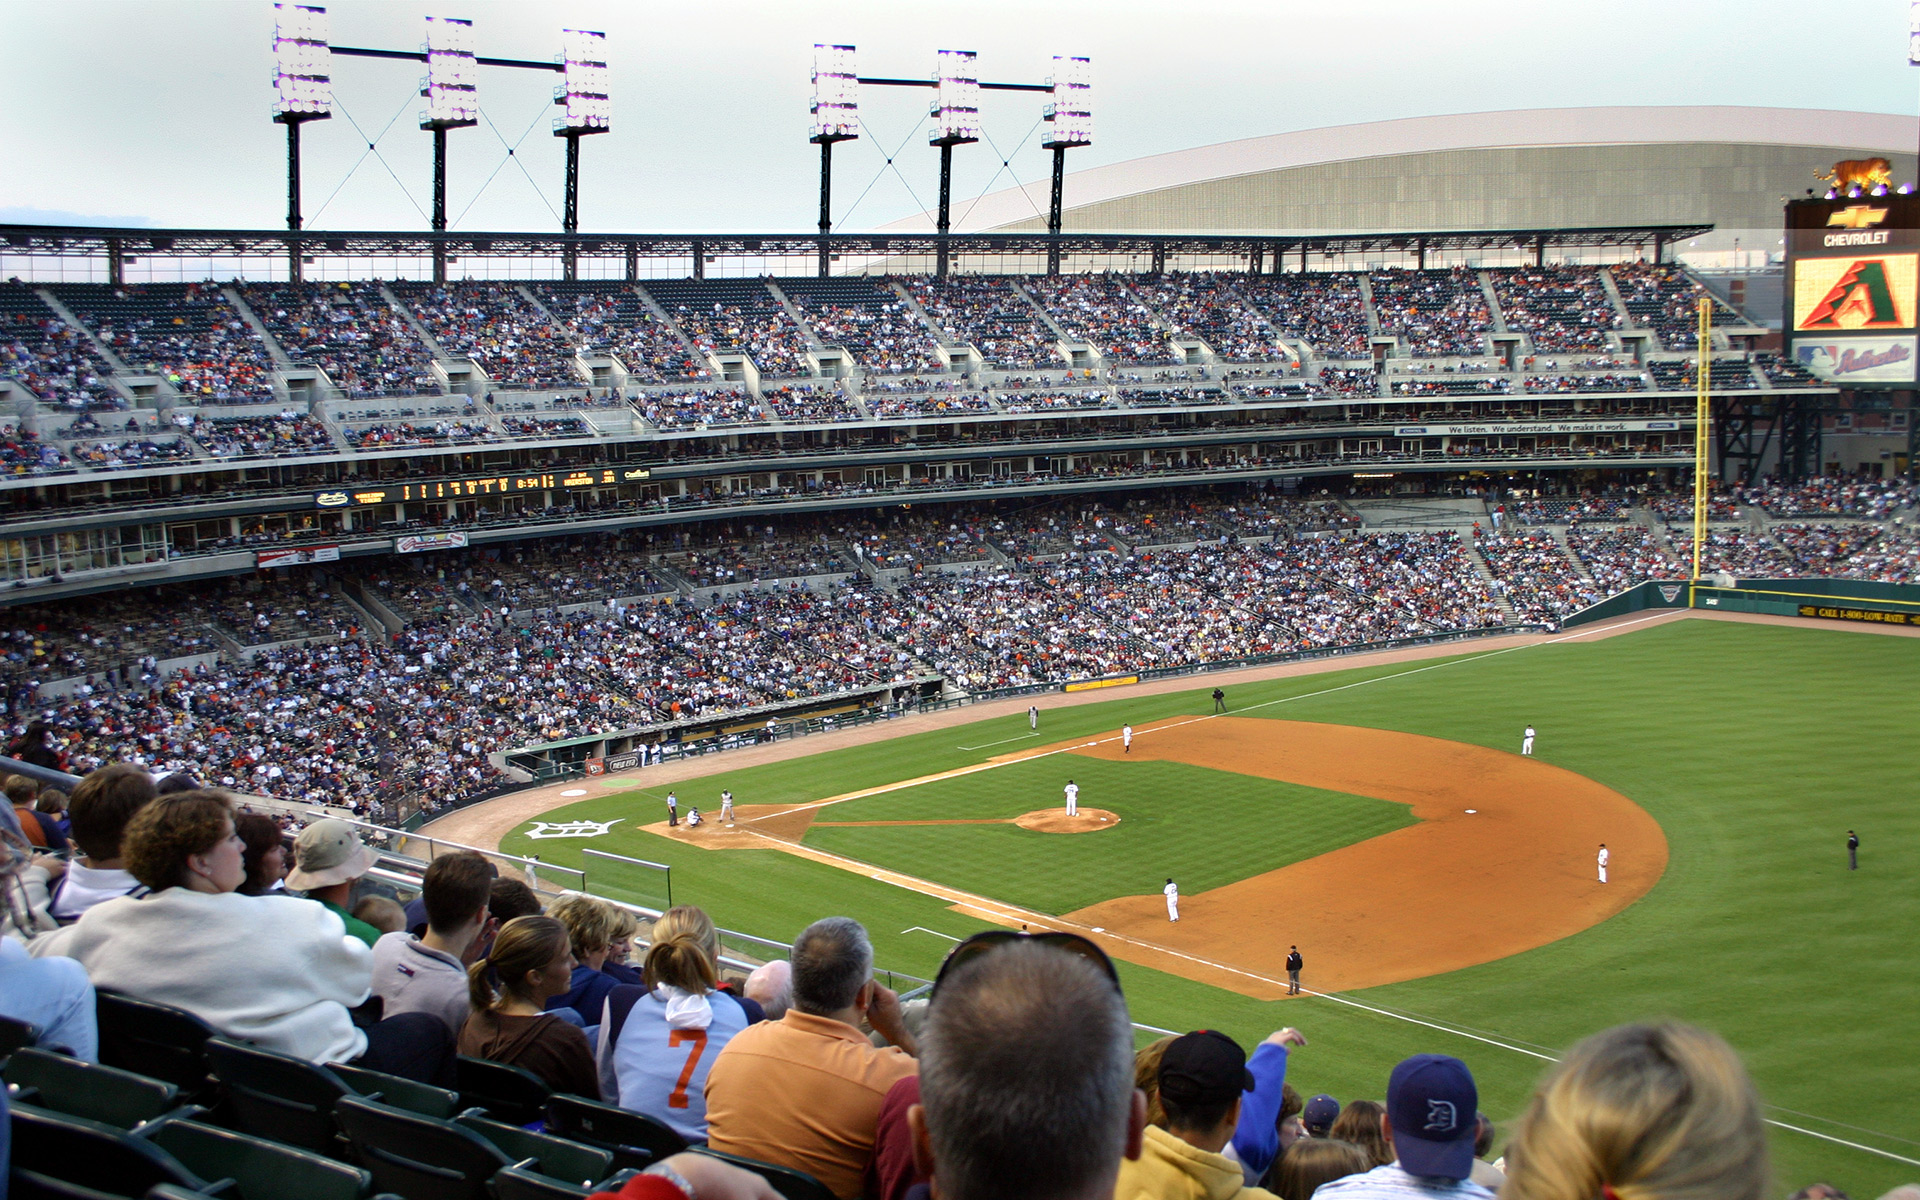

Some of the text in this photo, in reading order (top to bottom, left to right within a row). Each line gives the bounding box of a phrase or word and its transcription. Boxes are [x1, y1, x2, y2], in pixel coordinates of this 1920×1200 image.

[1824, 231, 1889, 247] CHEVROLET
[1449, 426, 1462, 434] We
[1464, 425, 1488, 433] listen.
[1507, 424, 1553, 432] understand.
[1573, 423, 1594, 431] make
[1605, 423, 1626, 431] work.
[517, 478, 538, 489] 8:54
[1819, 608, 1907, 623] CALL 1-800-LOW-RATE
[668, 1029, 708, 1109] 7
